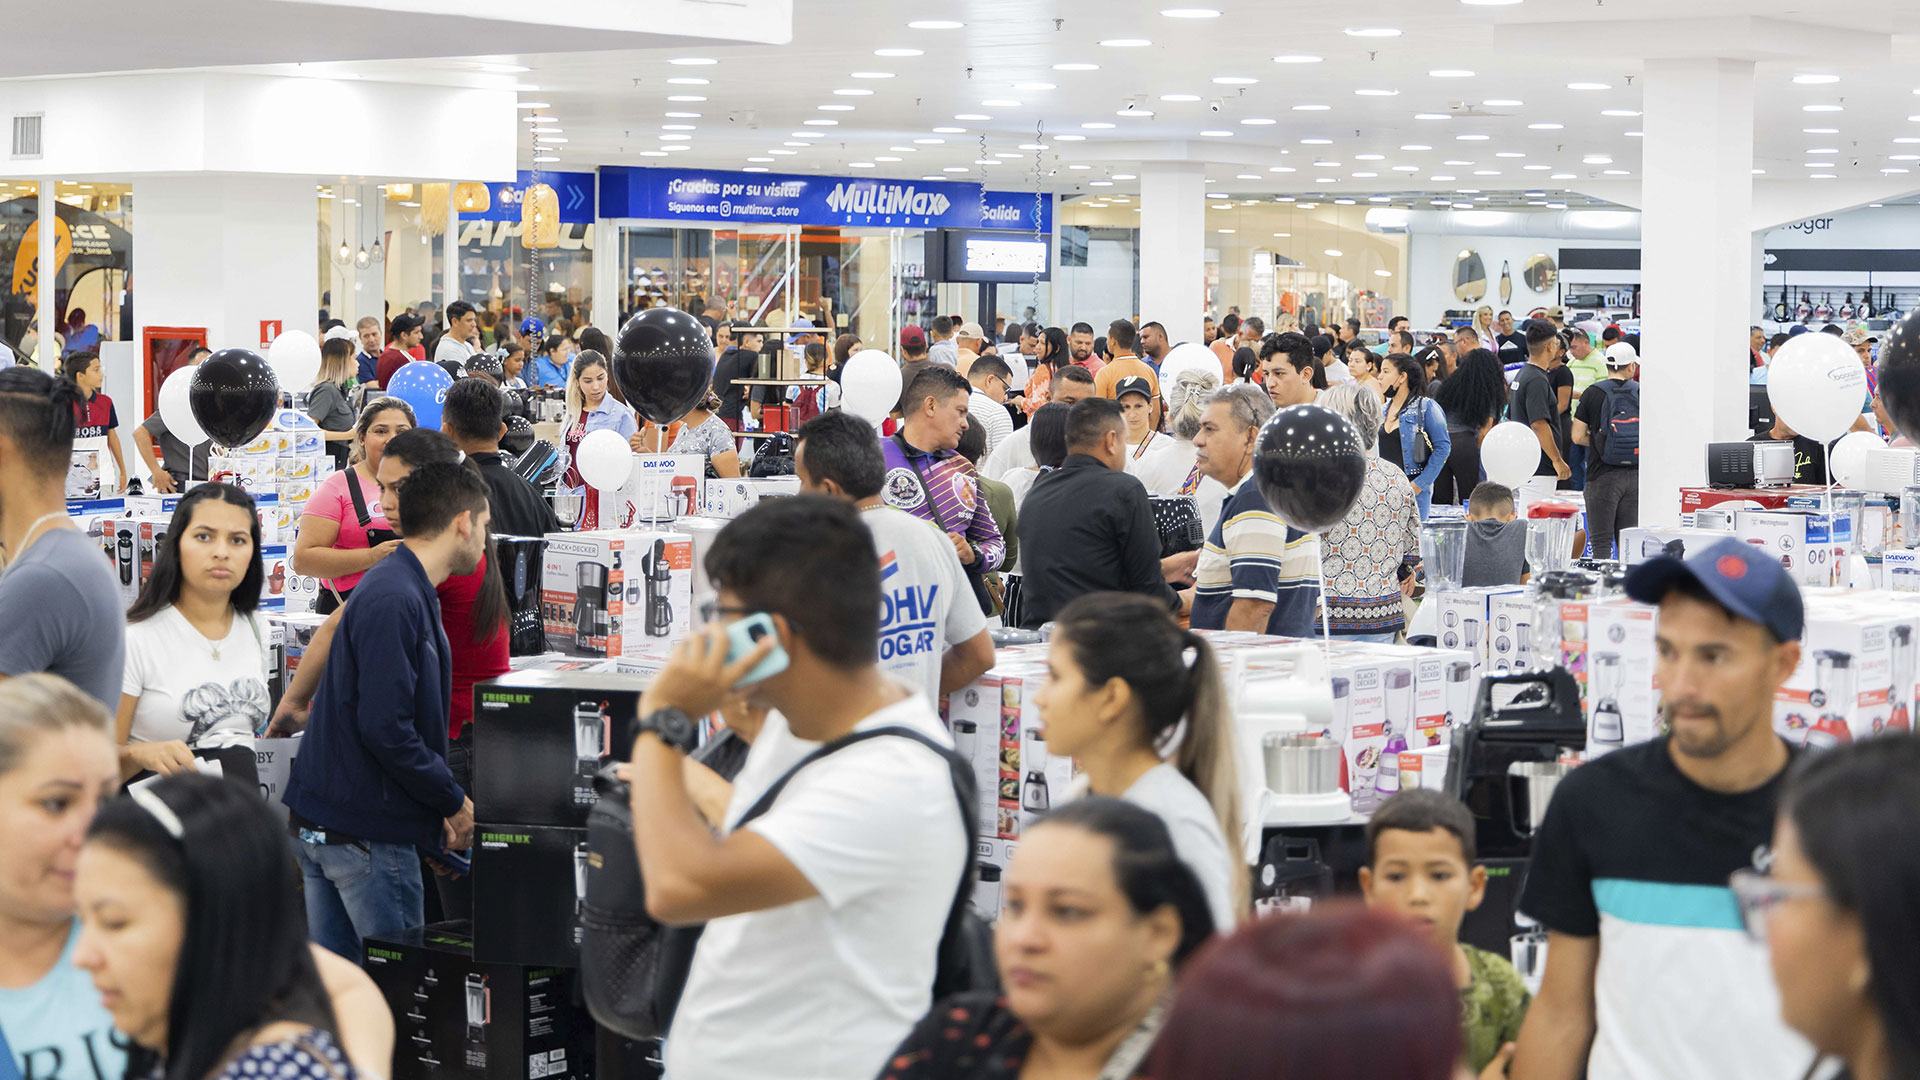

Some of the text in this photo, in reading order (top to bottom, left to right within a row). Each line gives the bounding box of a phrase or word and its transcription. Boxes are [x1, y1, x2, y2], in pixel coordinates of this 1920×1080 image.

[668, 178, 800, 198] ¡Gracias por su visita!
[831, 183, 942, 215] MultiMax
[668, 201, 799, 217] Síguenos en: multimax_store
[982, 204, 1020, 221] Salida
[549, 542, 597, 555] BLACK+DECKER
[876, 630, 935, 664] OGAR
[482, 692, 532, 704] FRIGILUX
[481, 833, 531, 844] FRIGILUX
